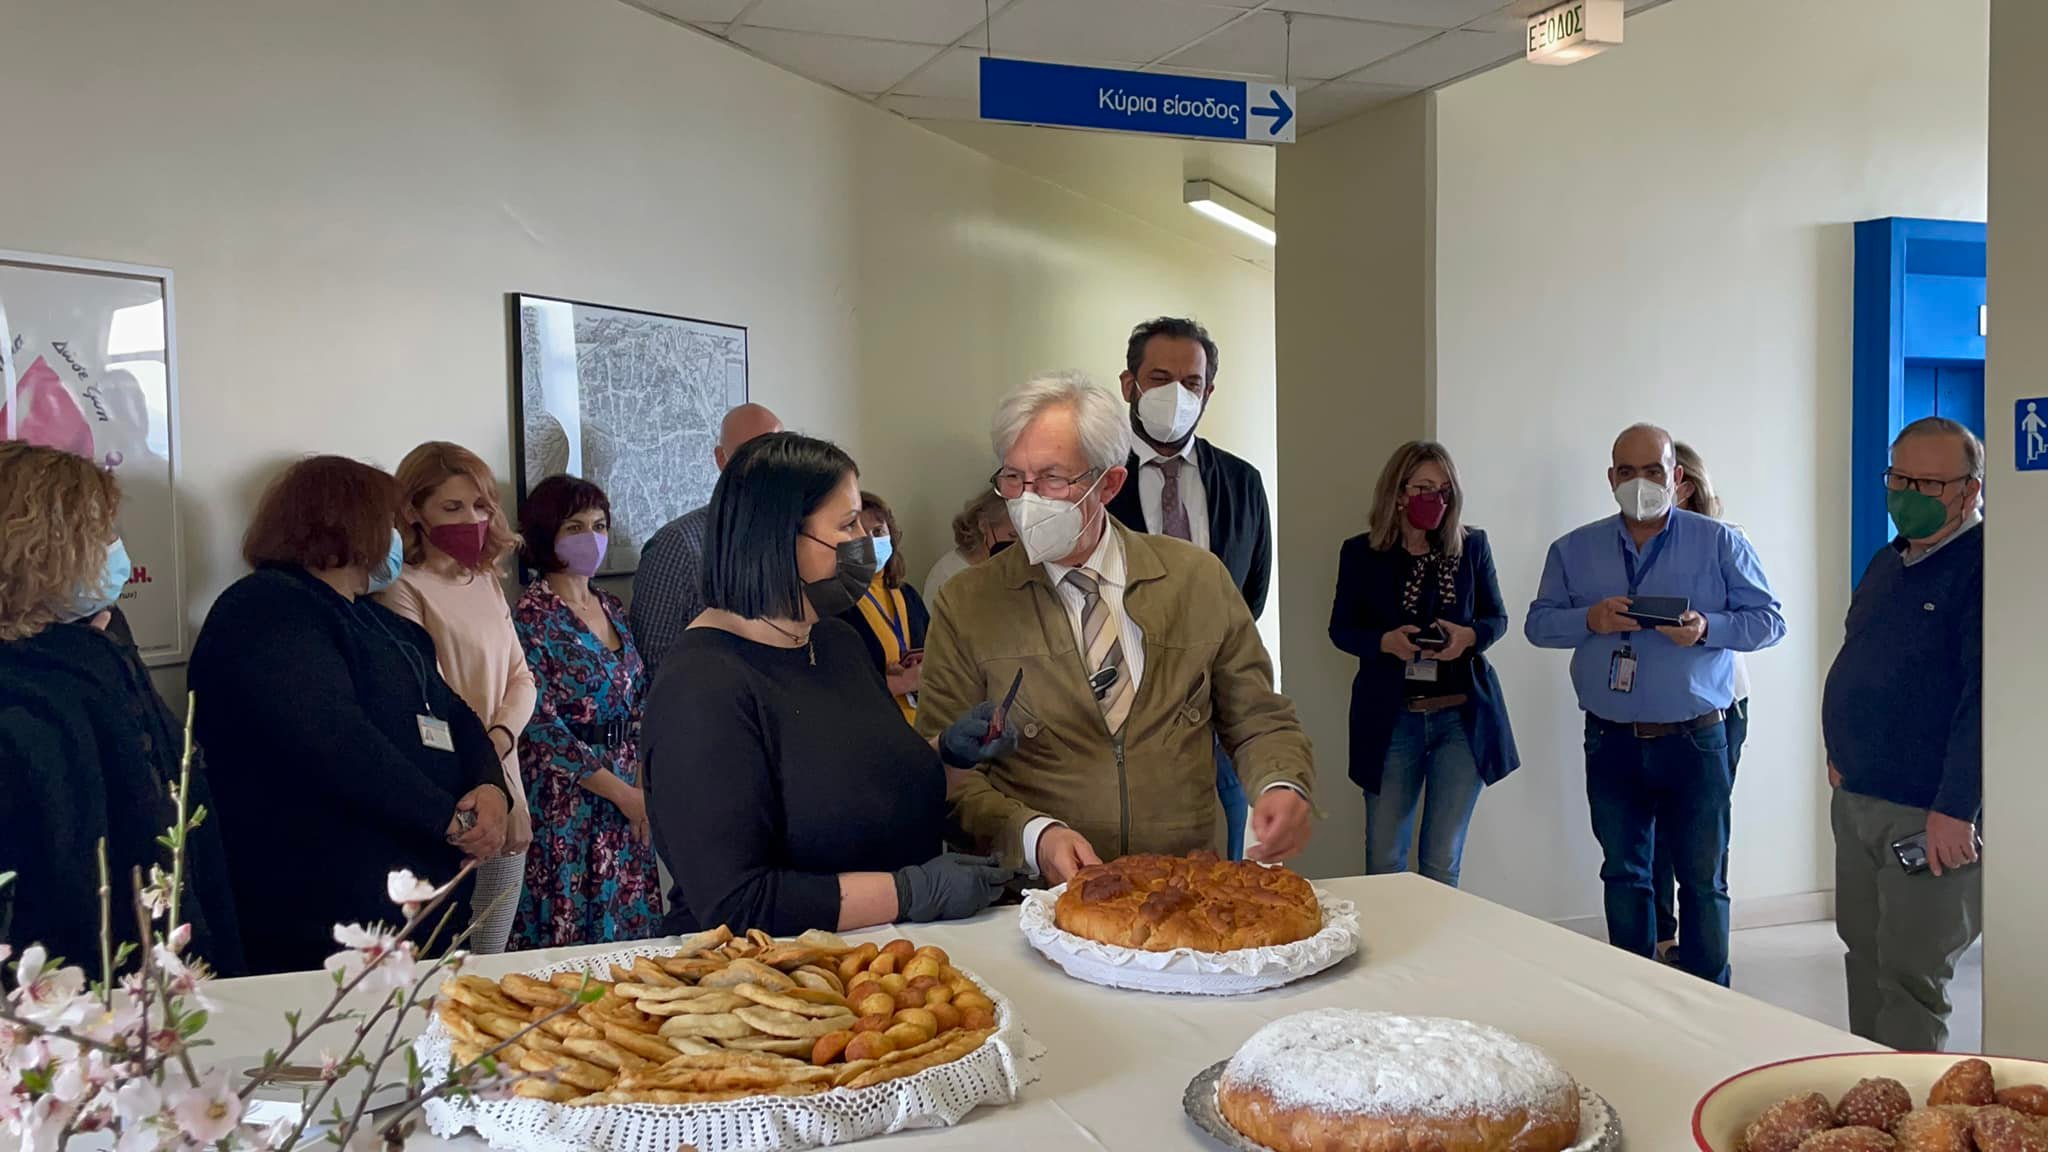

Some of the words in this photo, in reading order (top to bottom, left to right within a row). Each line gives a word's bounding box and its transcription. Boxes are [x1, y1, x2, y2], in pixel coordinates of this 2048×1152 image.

[1528, 5, 1583, 52] ΕΞΟΔΟΣ
[1099, 87, 1157, 116] Κύρια
[1163, 94, 1240, 125] είσοδος
